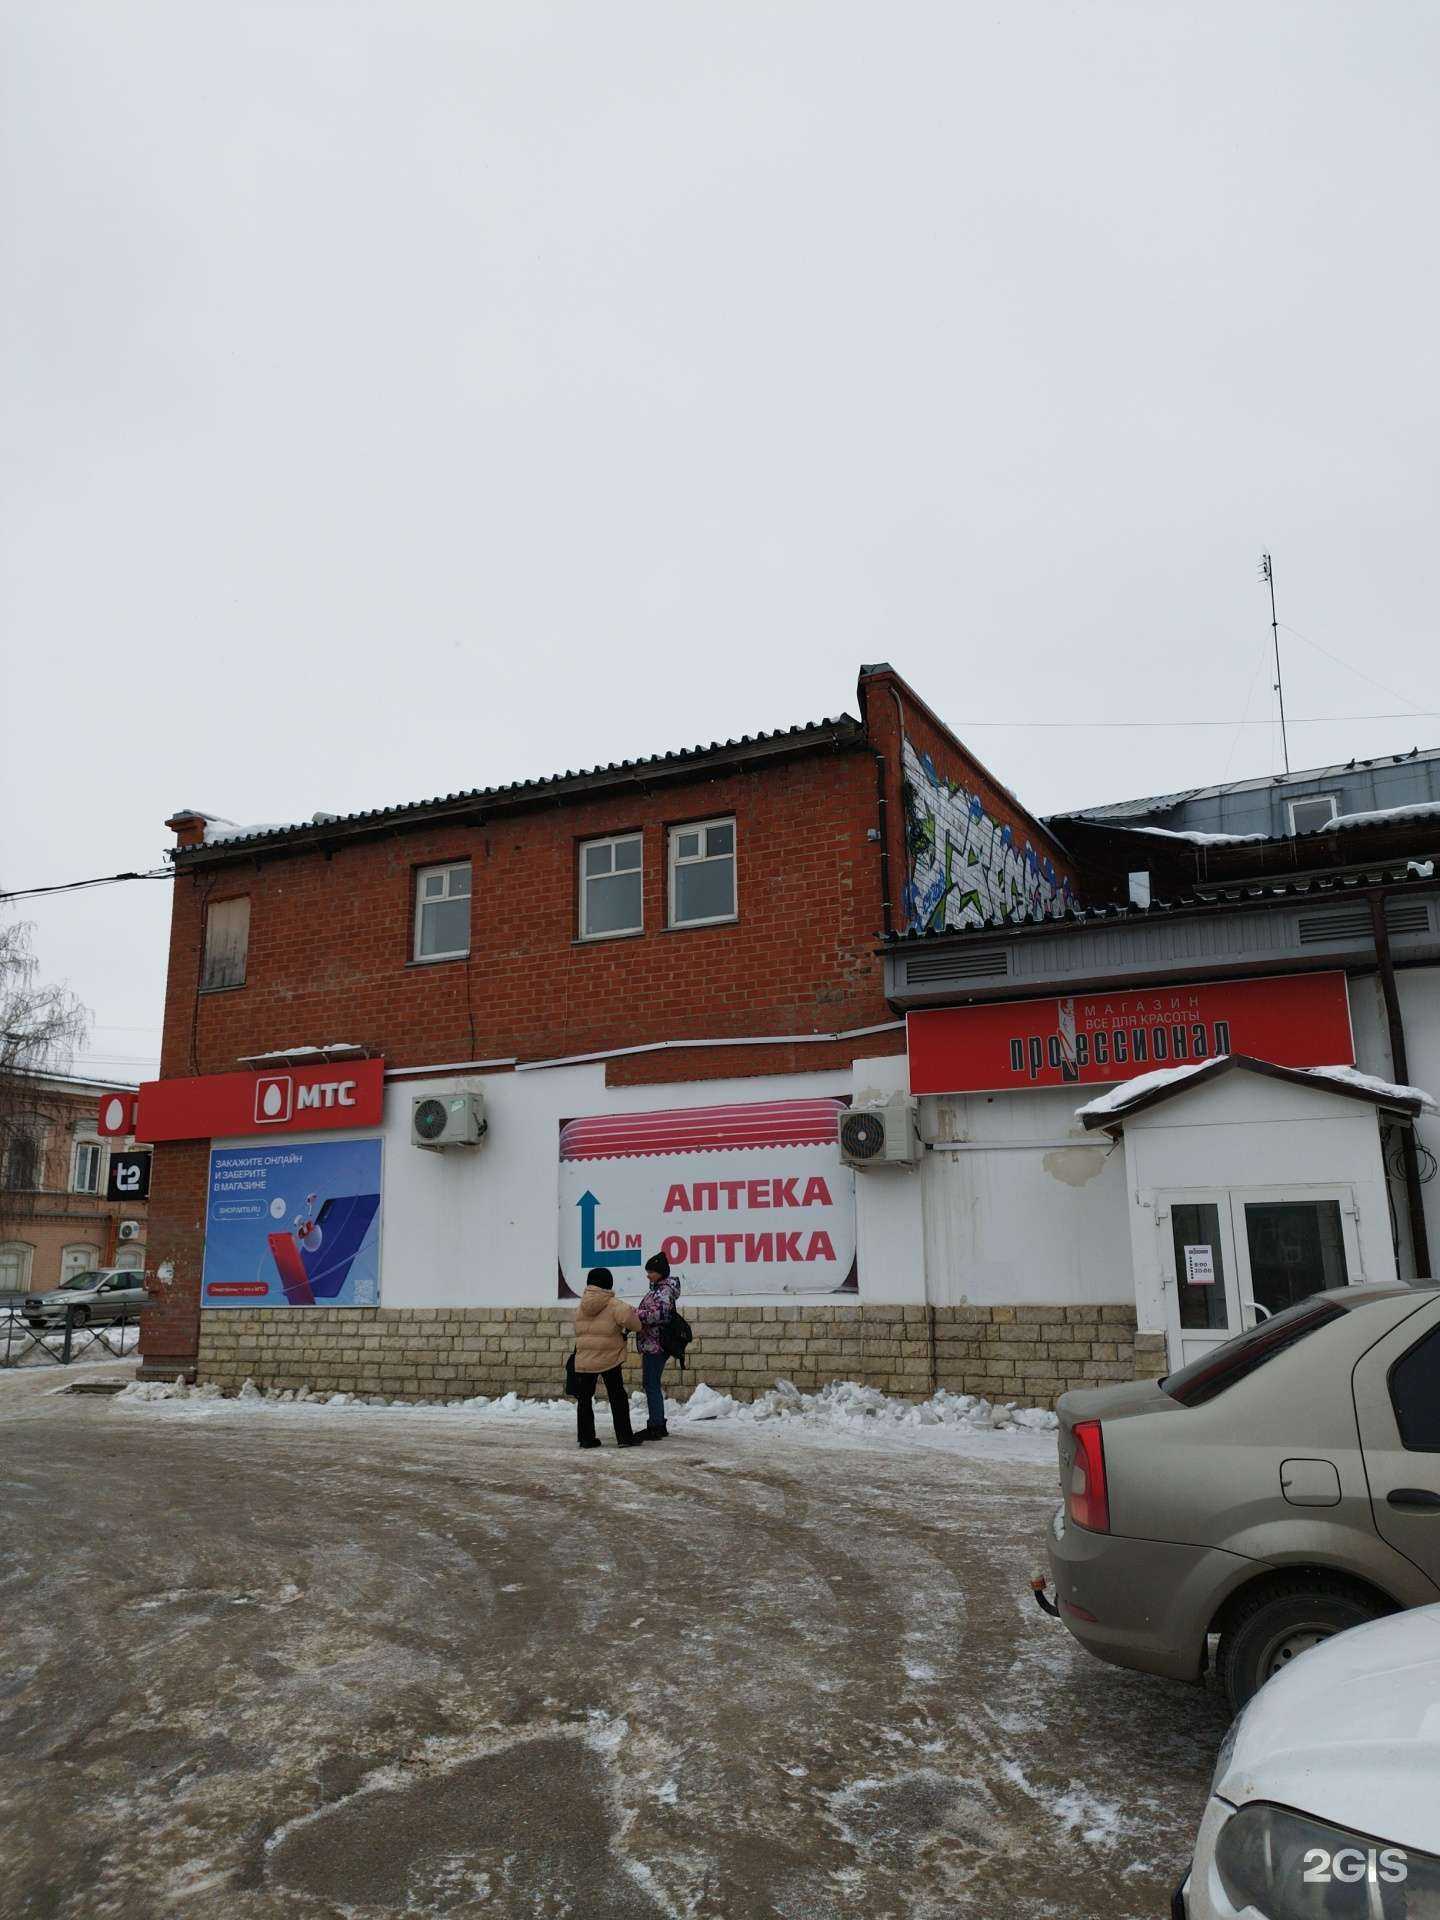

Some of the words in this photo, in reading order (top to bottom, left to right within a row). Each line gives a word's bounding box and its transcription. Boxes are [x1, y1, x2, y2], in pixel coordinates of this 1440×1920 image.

[1085, 997, 1199, 1017] МАГАЗИН
[1085, 1017, 1109, 1030] ВСЕ
[1140, 1009, 1200, 1025] КРАСОТЫ
[297, 1080, 356, 1110] МТС
[215, 1157, 263, 1168] ЗАКАЖИТЕ
[264, 1153, 303, 1166] ОНЛАЙН
[116, 1162, 141, 1191] t2
[215, 1171, 221, 1180] И
[222, 1168, 267, 1179] ЗАБЕРИТЕ
[214, 1184, 219, 1192] В
[221, 1181, 266, 1191] МАГАЗИНЕ
[663, 1177, 833, 1212] АПТЕКА
[597, 1230, 620, 1250] 10
[661, 1231, 837, 1265] ОПТИКА
